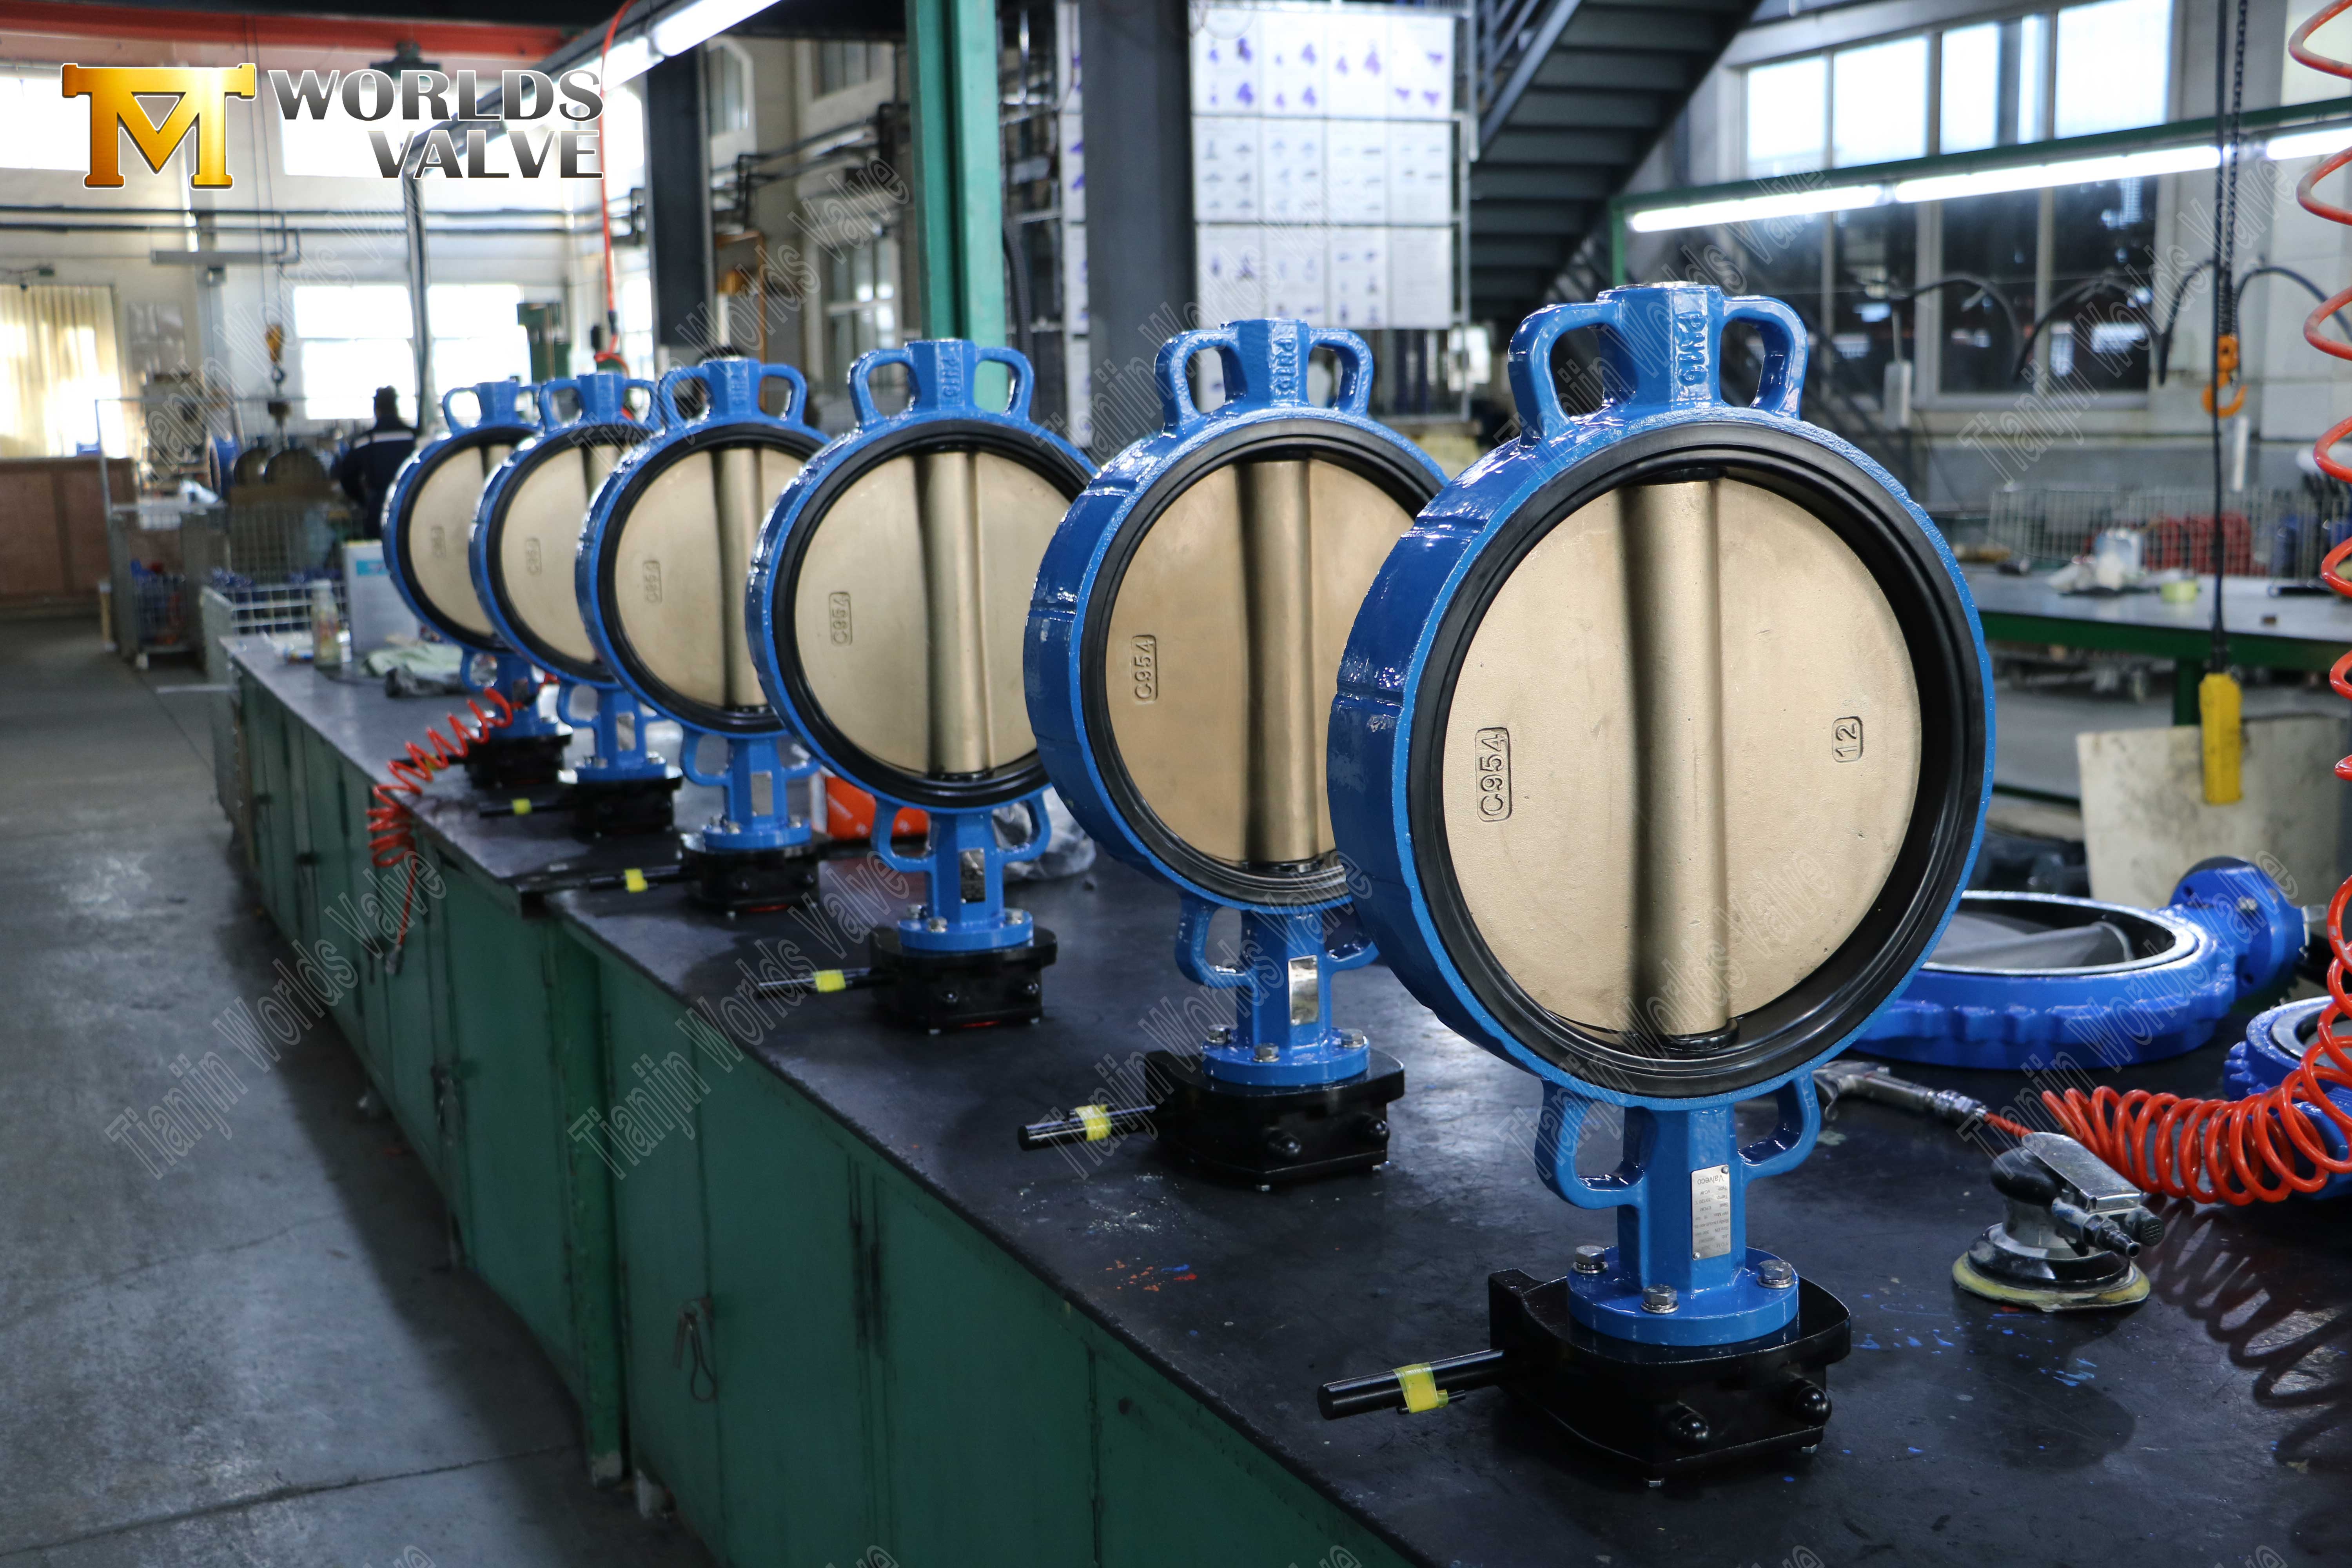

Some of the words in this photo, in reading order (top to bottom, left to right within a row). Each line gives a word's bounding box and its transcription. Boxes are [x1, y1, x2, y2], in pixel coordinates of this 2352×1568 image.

[832, 596, 849, 644] C954
[1134, 639, 1154, 699] C954
[1834, 723, 1857, 757] 12
[1479, 734, 1505, 816] C954
[1697, 1175, 1724, 1185] Valveco
